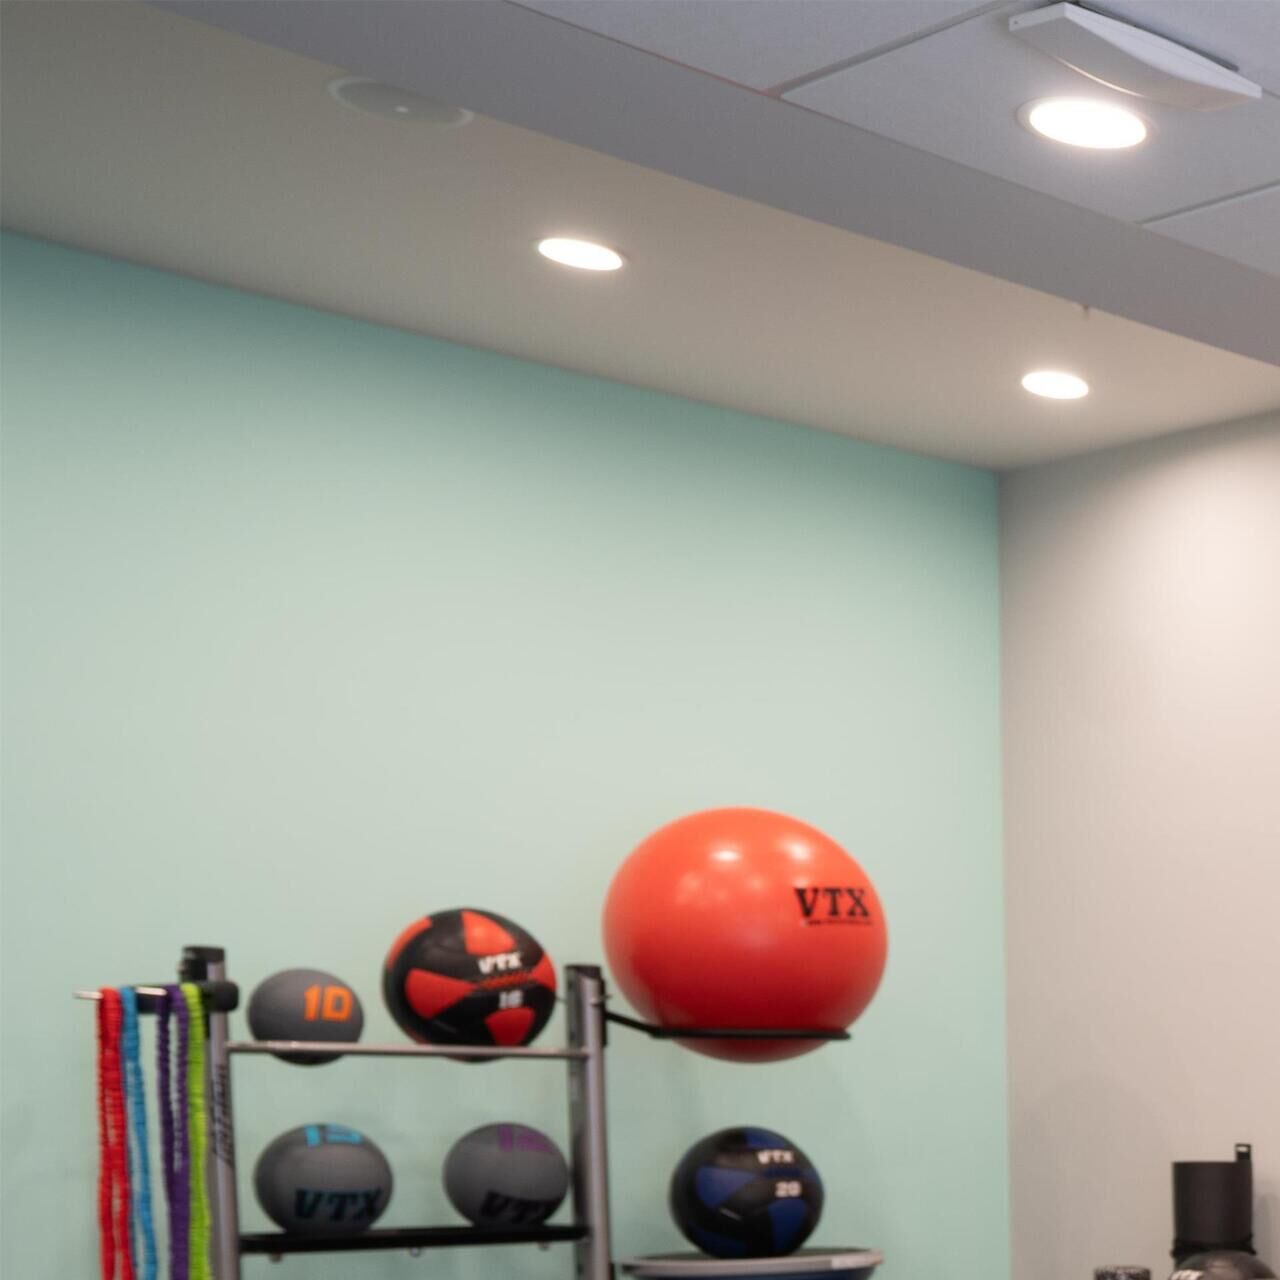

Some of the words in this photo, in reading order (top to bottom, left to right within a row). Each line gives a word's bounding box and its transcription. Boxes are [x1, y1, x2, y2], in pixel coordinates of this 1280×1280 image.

[793, 887, 870, 918] VTX
[477, 951, 522, 974] VTX
[304, 984, 353, 1022] 10
[757, 1149, 794, 1164] VTX
[297, 1188, 381, 1221] VTX
